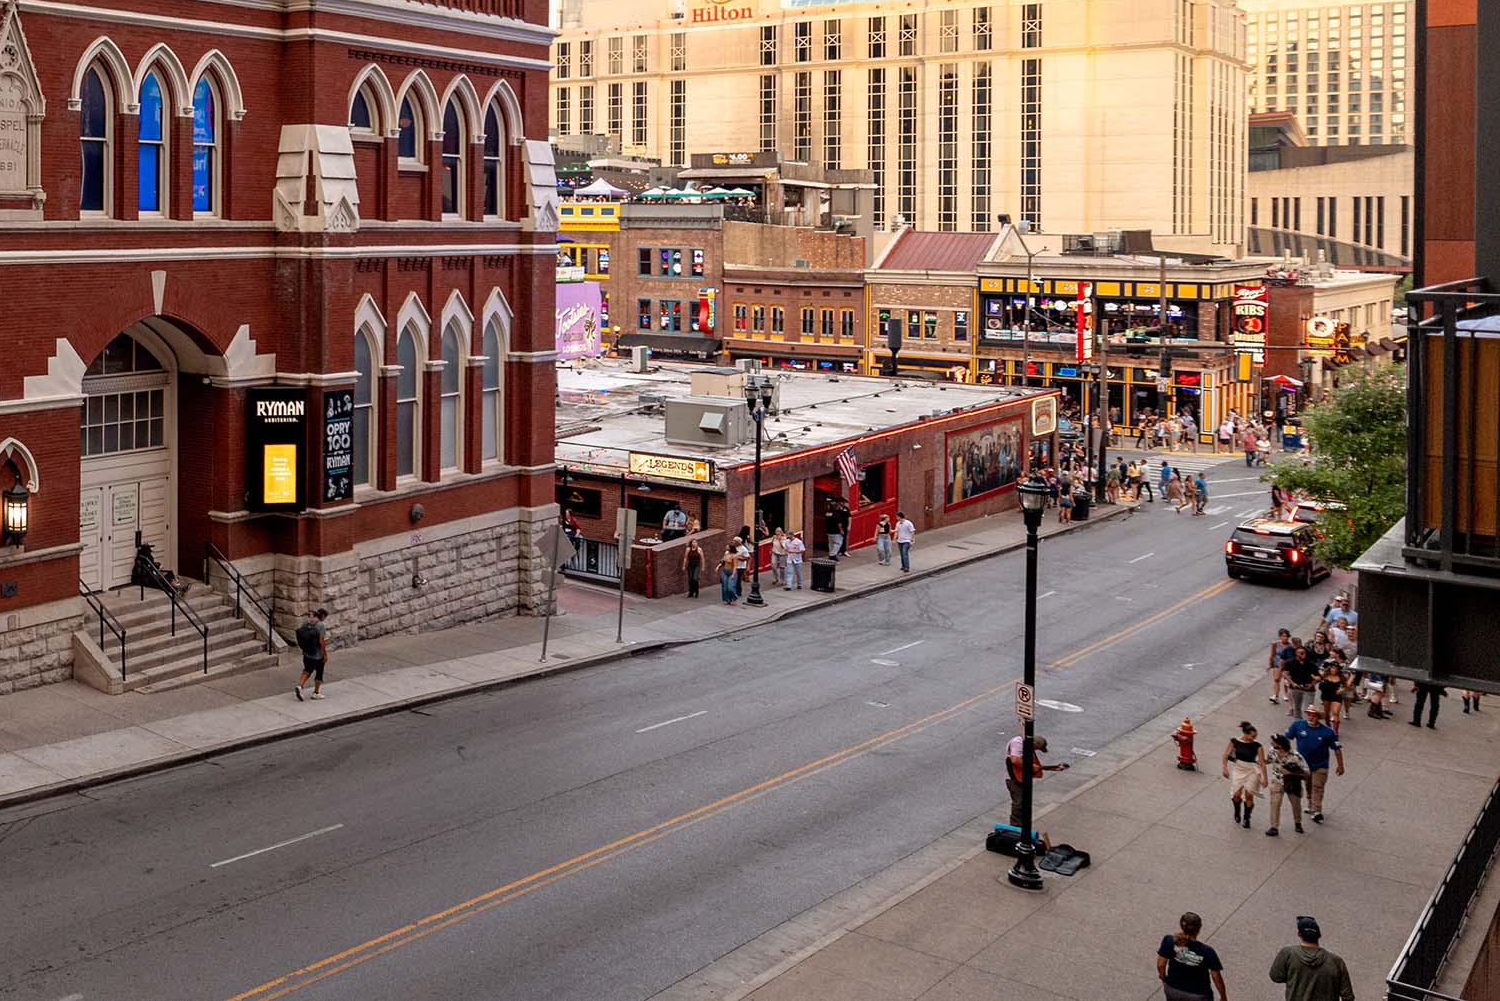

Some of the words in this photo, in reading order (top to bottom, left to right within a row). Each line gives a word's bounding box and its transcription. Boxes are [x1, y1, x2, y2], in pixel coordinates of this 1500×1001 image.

[692, 5, 753, 23] Hilton
[1235, 304, 1265, 316] RIBS
[256, 400, 305, 416] RYMAN
[326, 421, 351, 436] OPRY
[327, 434, 351, 451] 100
[326, 454, 351, 469] RYMAN
